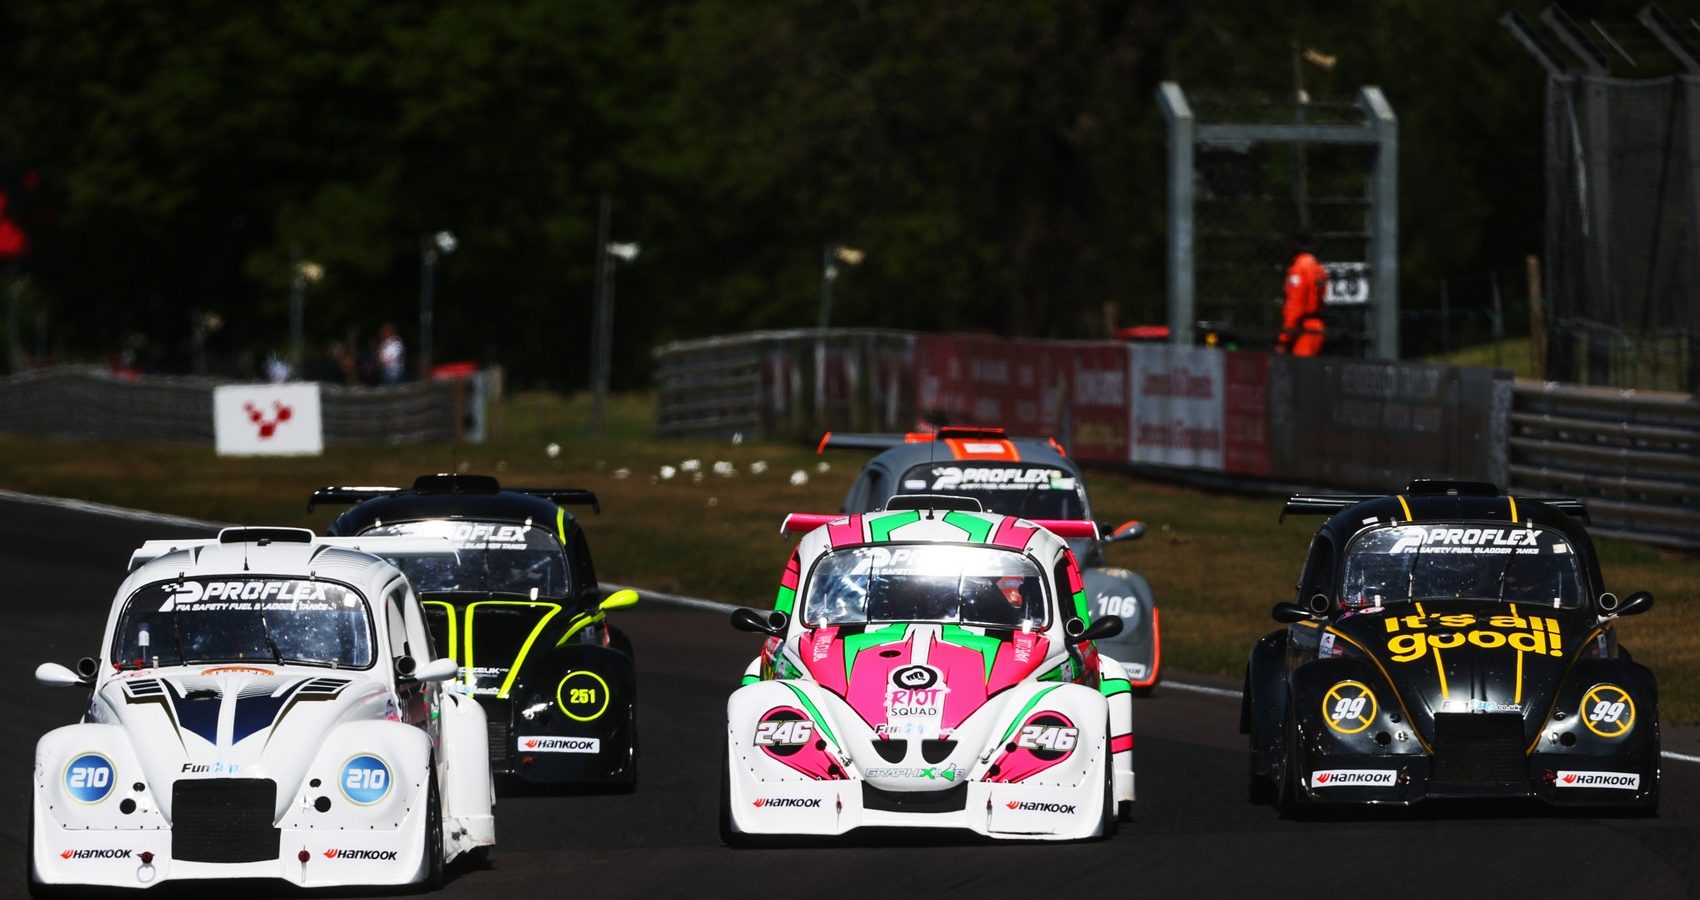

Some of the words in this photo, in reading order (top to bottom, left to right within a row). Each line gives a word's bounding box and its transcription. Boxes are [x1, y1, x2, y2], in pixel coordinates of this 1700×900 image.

[962, 468, 1050, 483] PROFLEX
[1427, 528, 1543, 546] PROFLEX
[202, 581, 327, 600] PROFLEX
[192, 603, 229, 611] SAFETY
[229, 602, 253, 610] FUEL
[1098, 595, 1137, 619] 106
[1490, 615, 1561, 634] all
[1387, 630, 1563, 662] good!
[570, 688, 596, 704] 251
[891, 688, 944, 706] RIOT
[891, 707, 937, 717] SQUAD
[1331, 697, 1367, 720] 99
[1589, 700, 1626, 723] 99
[753, 719, 815, 747] 246
[1019, 724, 1079, 752] 246
[69, 766, 109, 789] 210
[346, 768, 386, 790] 210
